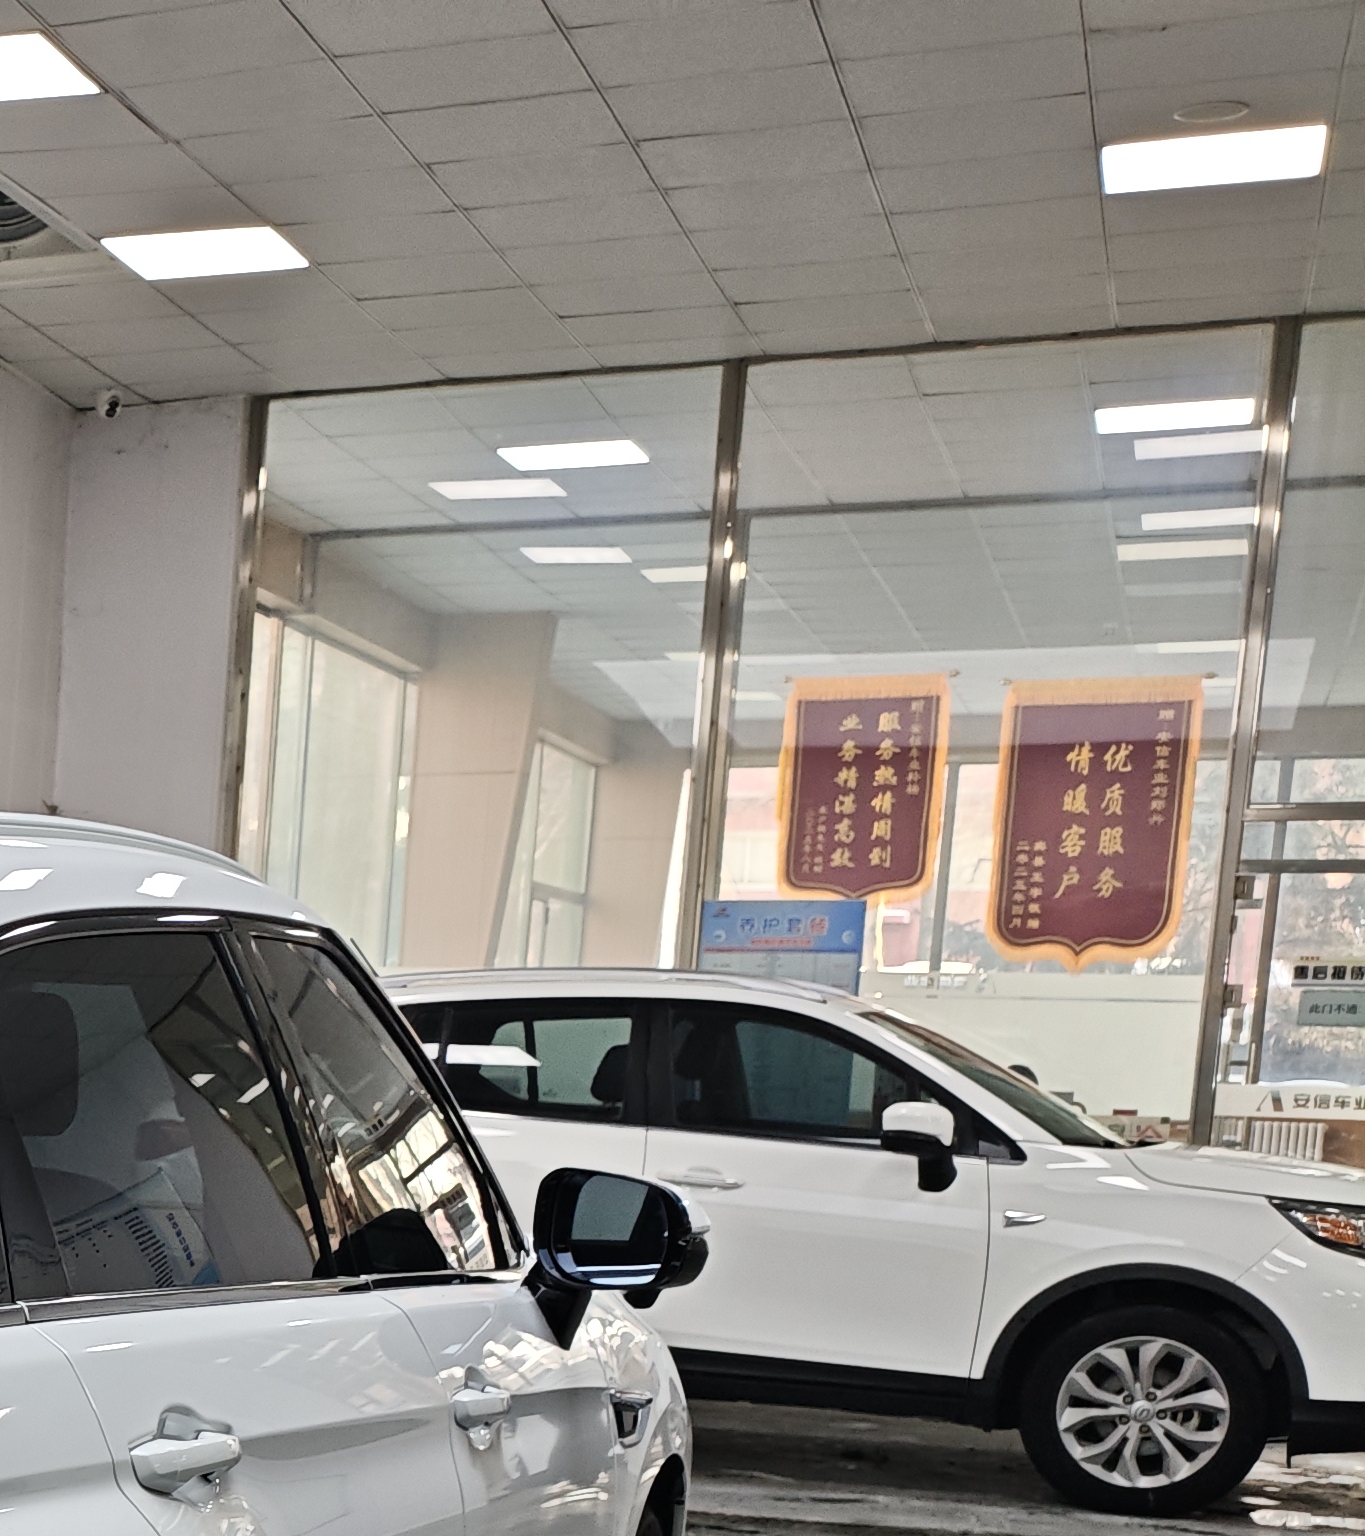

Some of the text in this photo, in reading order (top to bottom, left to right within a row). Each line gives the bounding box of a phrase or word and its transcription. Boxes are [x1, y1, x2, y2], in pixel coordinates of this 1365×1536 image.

[829, 715, 863, 870] 业务精湛高效
[868, 711, 902, 869] 服务热情周到
[1053, 742, 1095, 900] 情暖客户
[1092, 743, 1135, 900] 优质服务
[738, 916, 828, 936] 养护套餐
